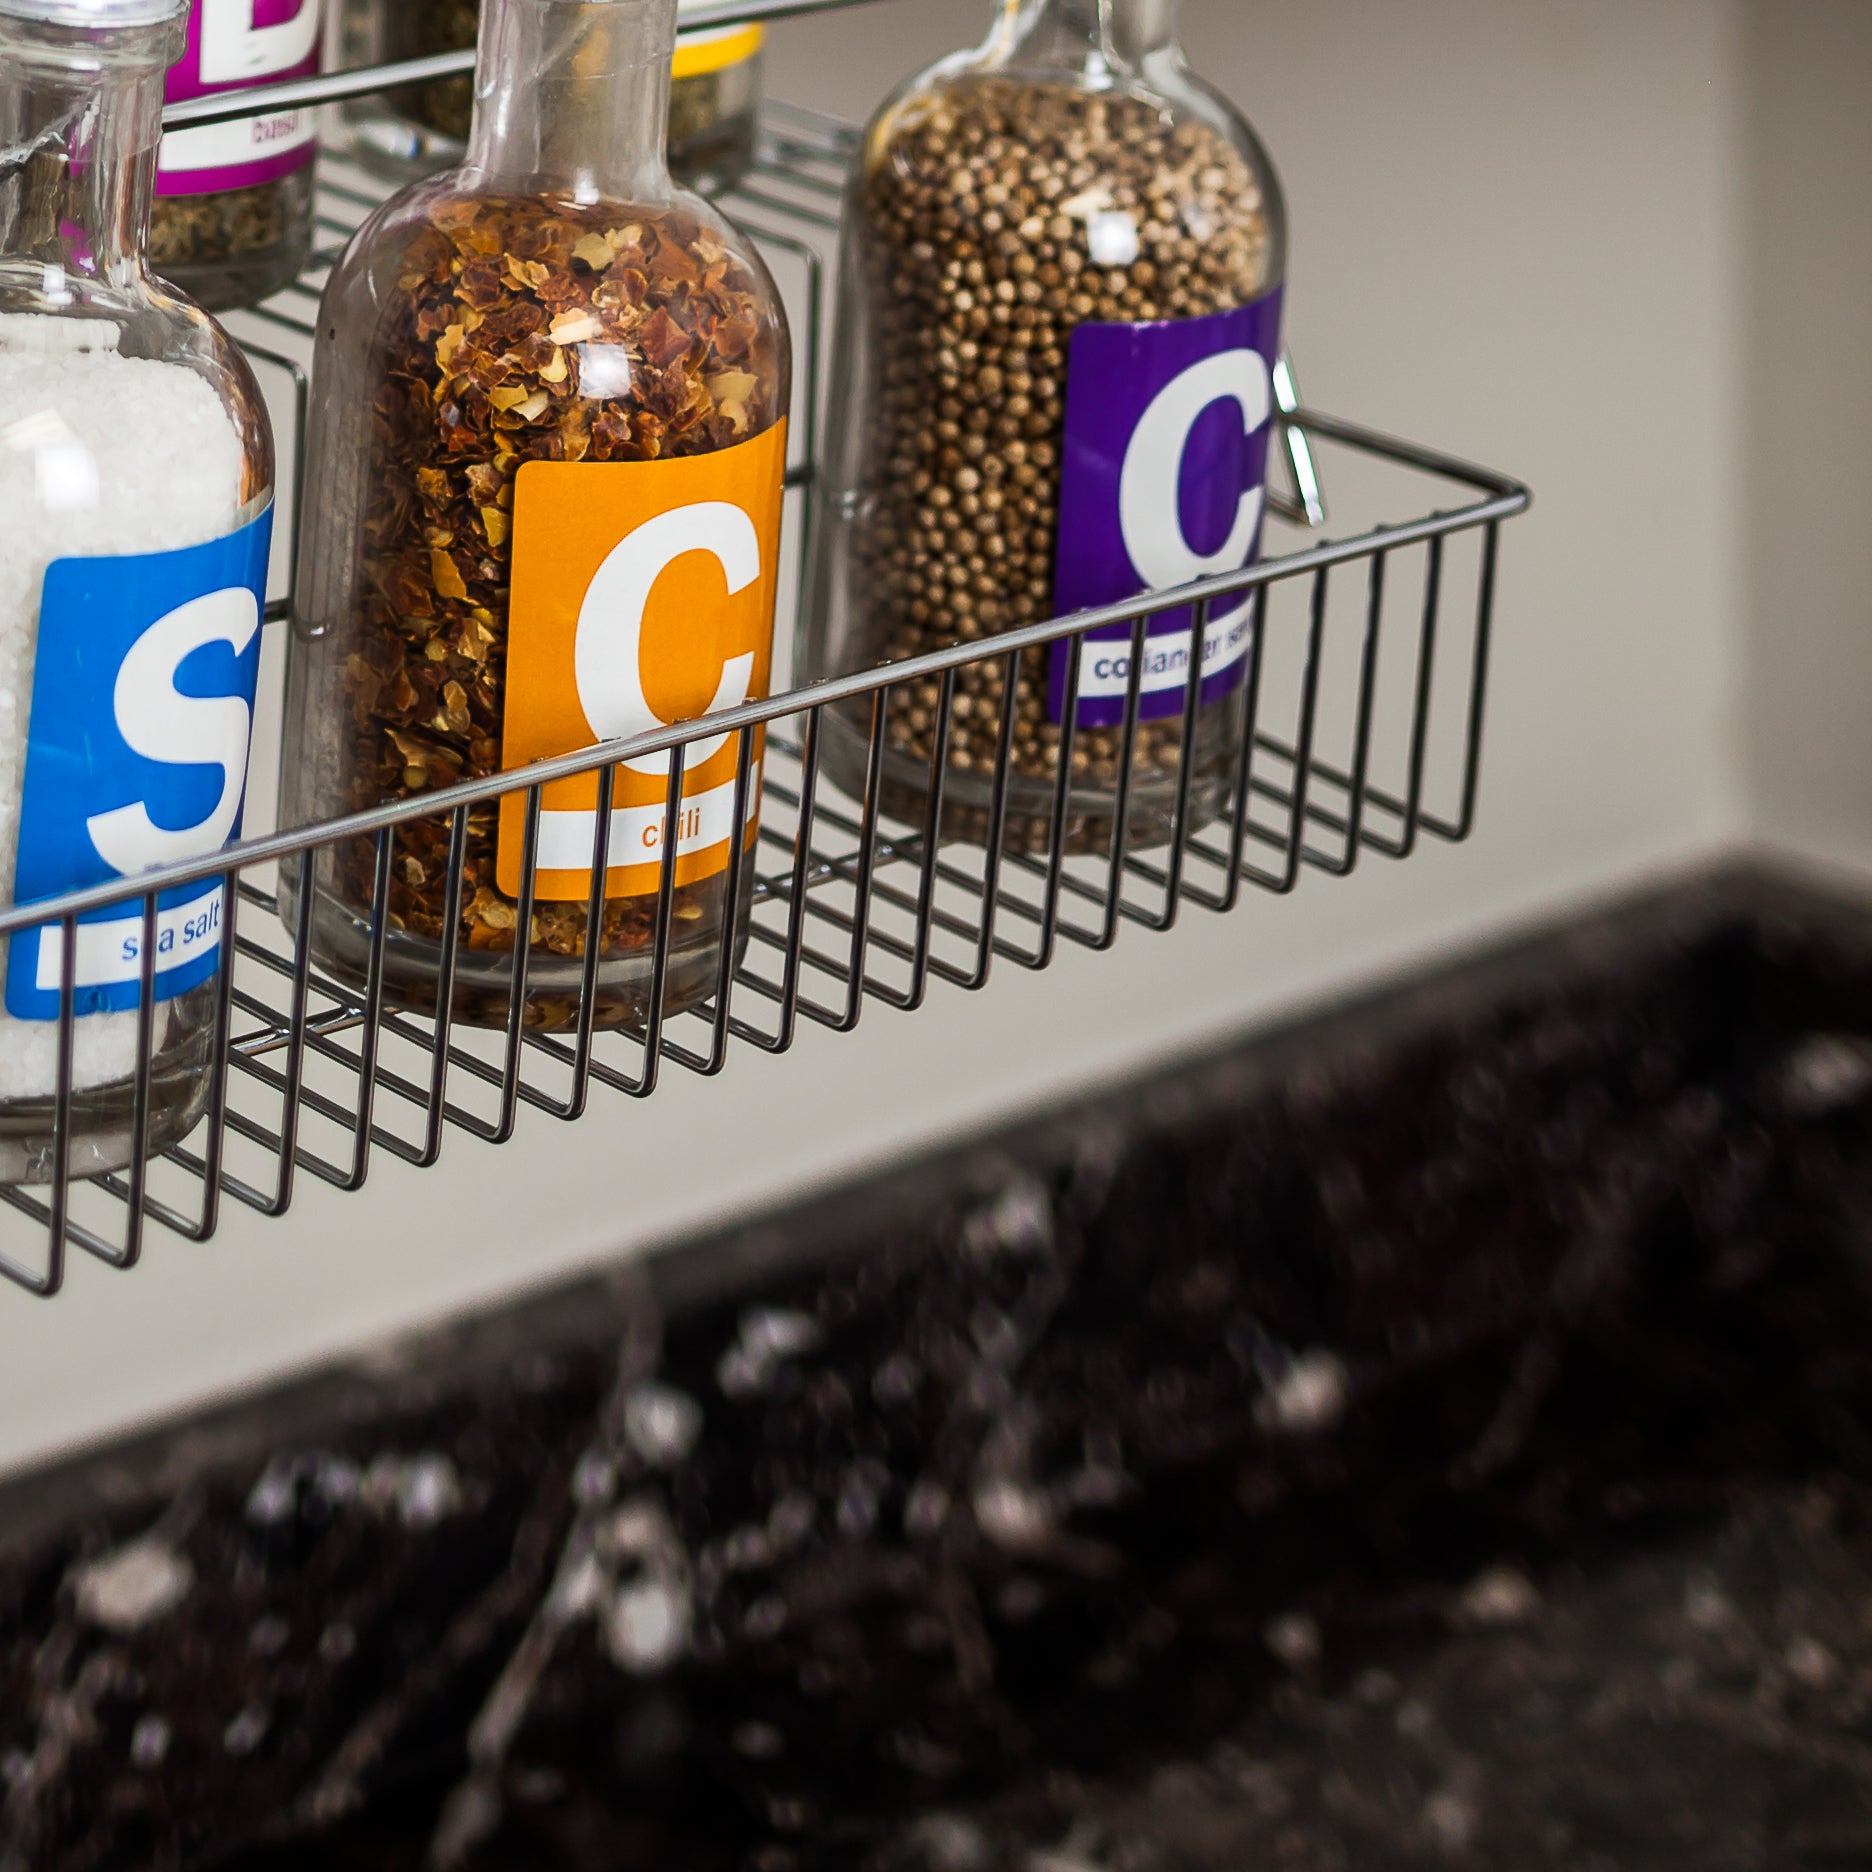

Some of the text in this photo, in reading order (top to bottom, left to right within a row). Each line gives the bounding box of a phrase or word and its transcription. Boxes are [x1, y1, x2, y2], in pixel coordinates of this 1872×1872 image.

[1119, 348, 1270, 592] C
[86, 586, 259, 878] S
[574, 501, 760, 775] C
[1094, 636, 1220, 680] coianer
[121, 900, 220, 961] sa salt
